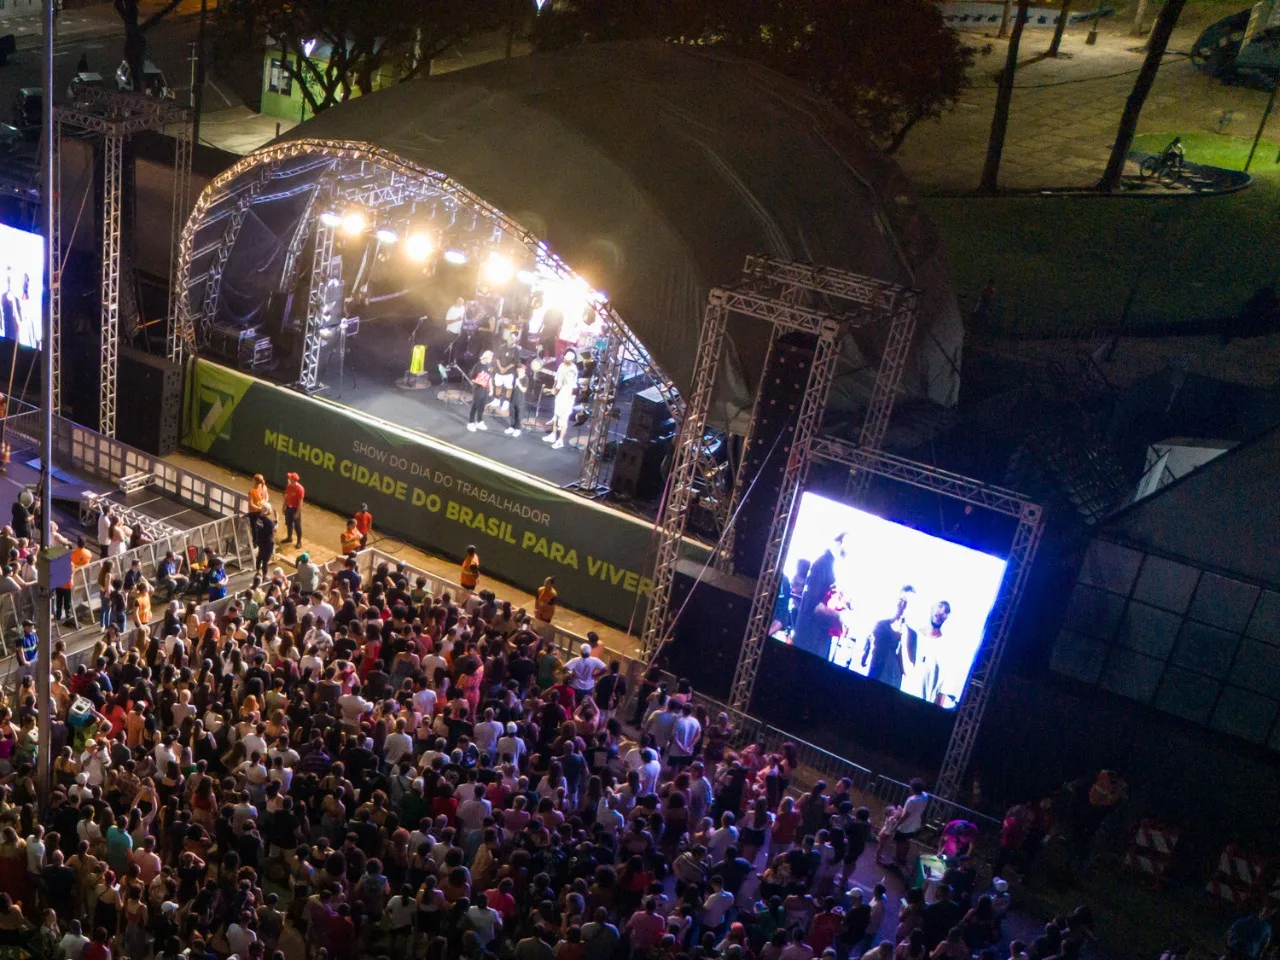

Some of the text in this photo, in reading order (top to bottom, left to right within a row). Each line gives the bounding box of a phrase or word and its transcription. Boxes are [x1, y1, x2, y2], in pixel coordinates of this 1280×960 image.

[264, 429, 654, 598] MELHOR CIDADE DO BRASIL PARA VIVER
[352, 440, 551, 527] SHOW DO DIA DO TRABALHADOR
